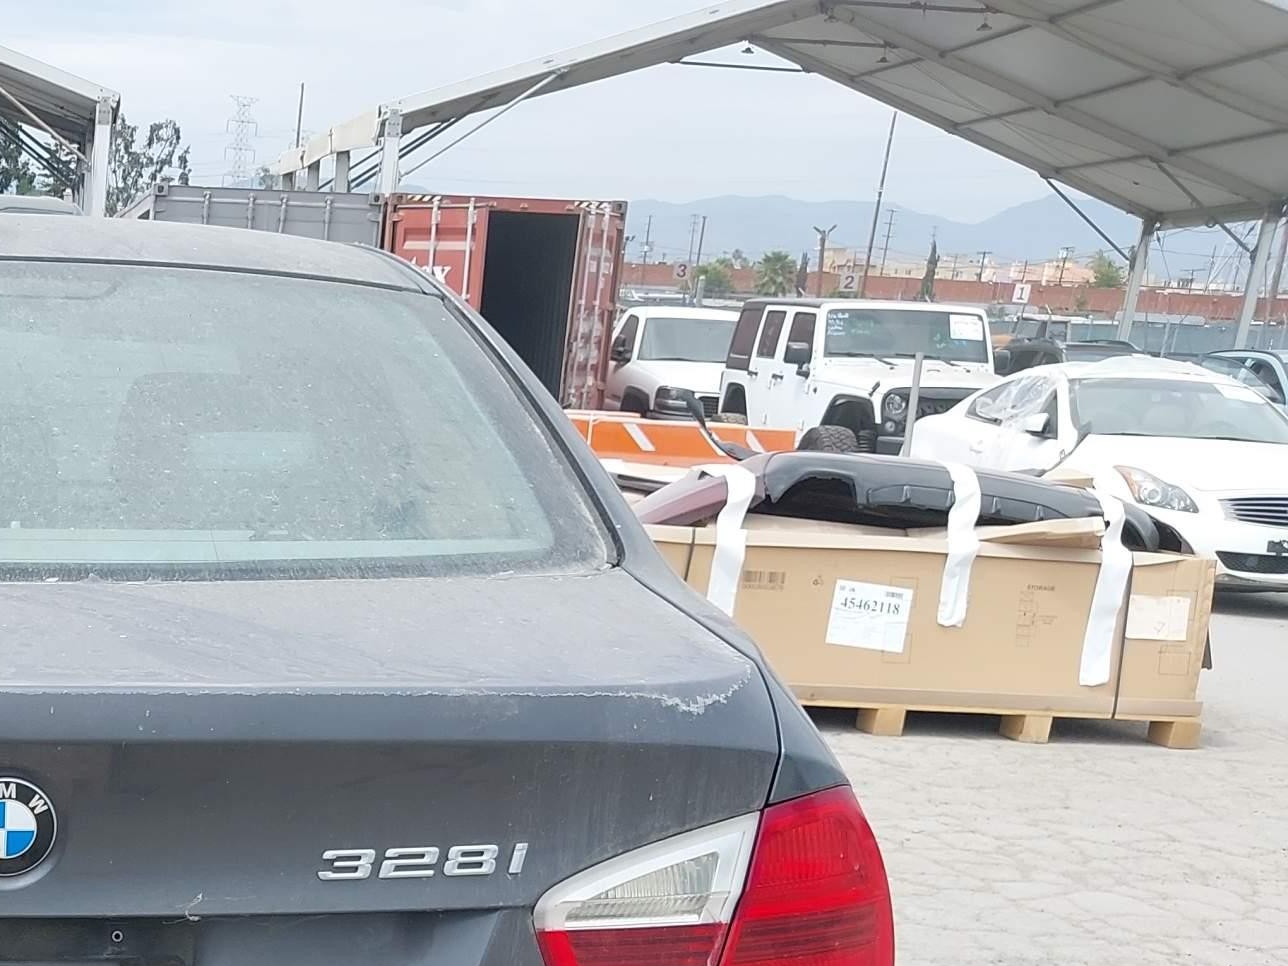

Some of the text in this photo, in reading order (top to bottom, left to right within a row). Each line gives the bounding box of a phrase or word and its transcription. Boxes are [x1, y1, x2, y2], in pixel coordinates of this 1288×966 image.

[676, 264, 687, 278] 3
[844, 275, 854, 289] 2
[1016, 286, 1025, 301] 1
[840, 597, 901, 615] 45462118
[317, 843, 528, 881] 328i
